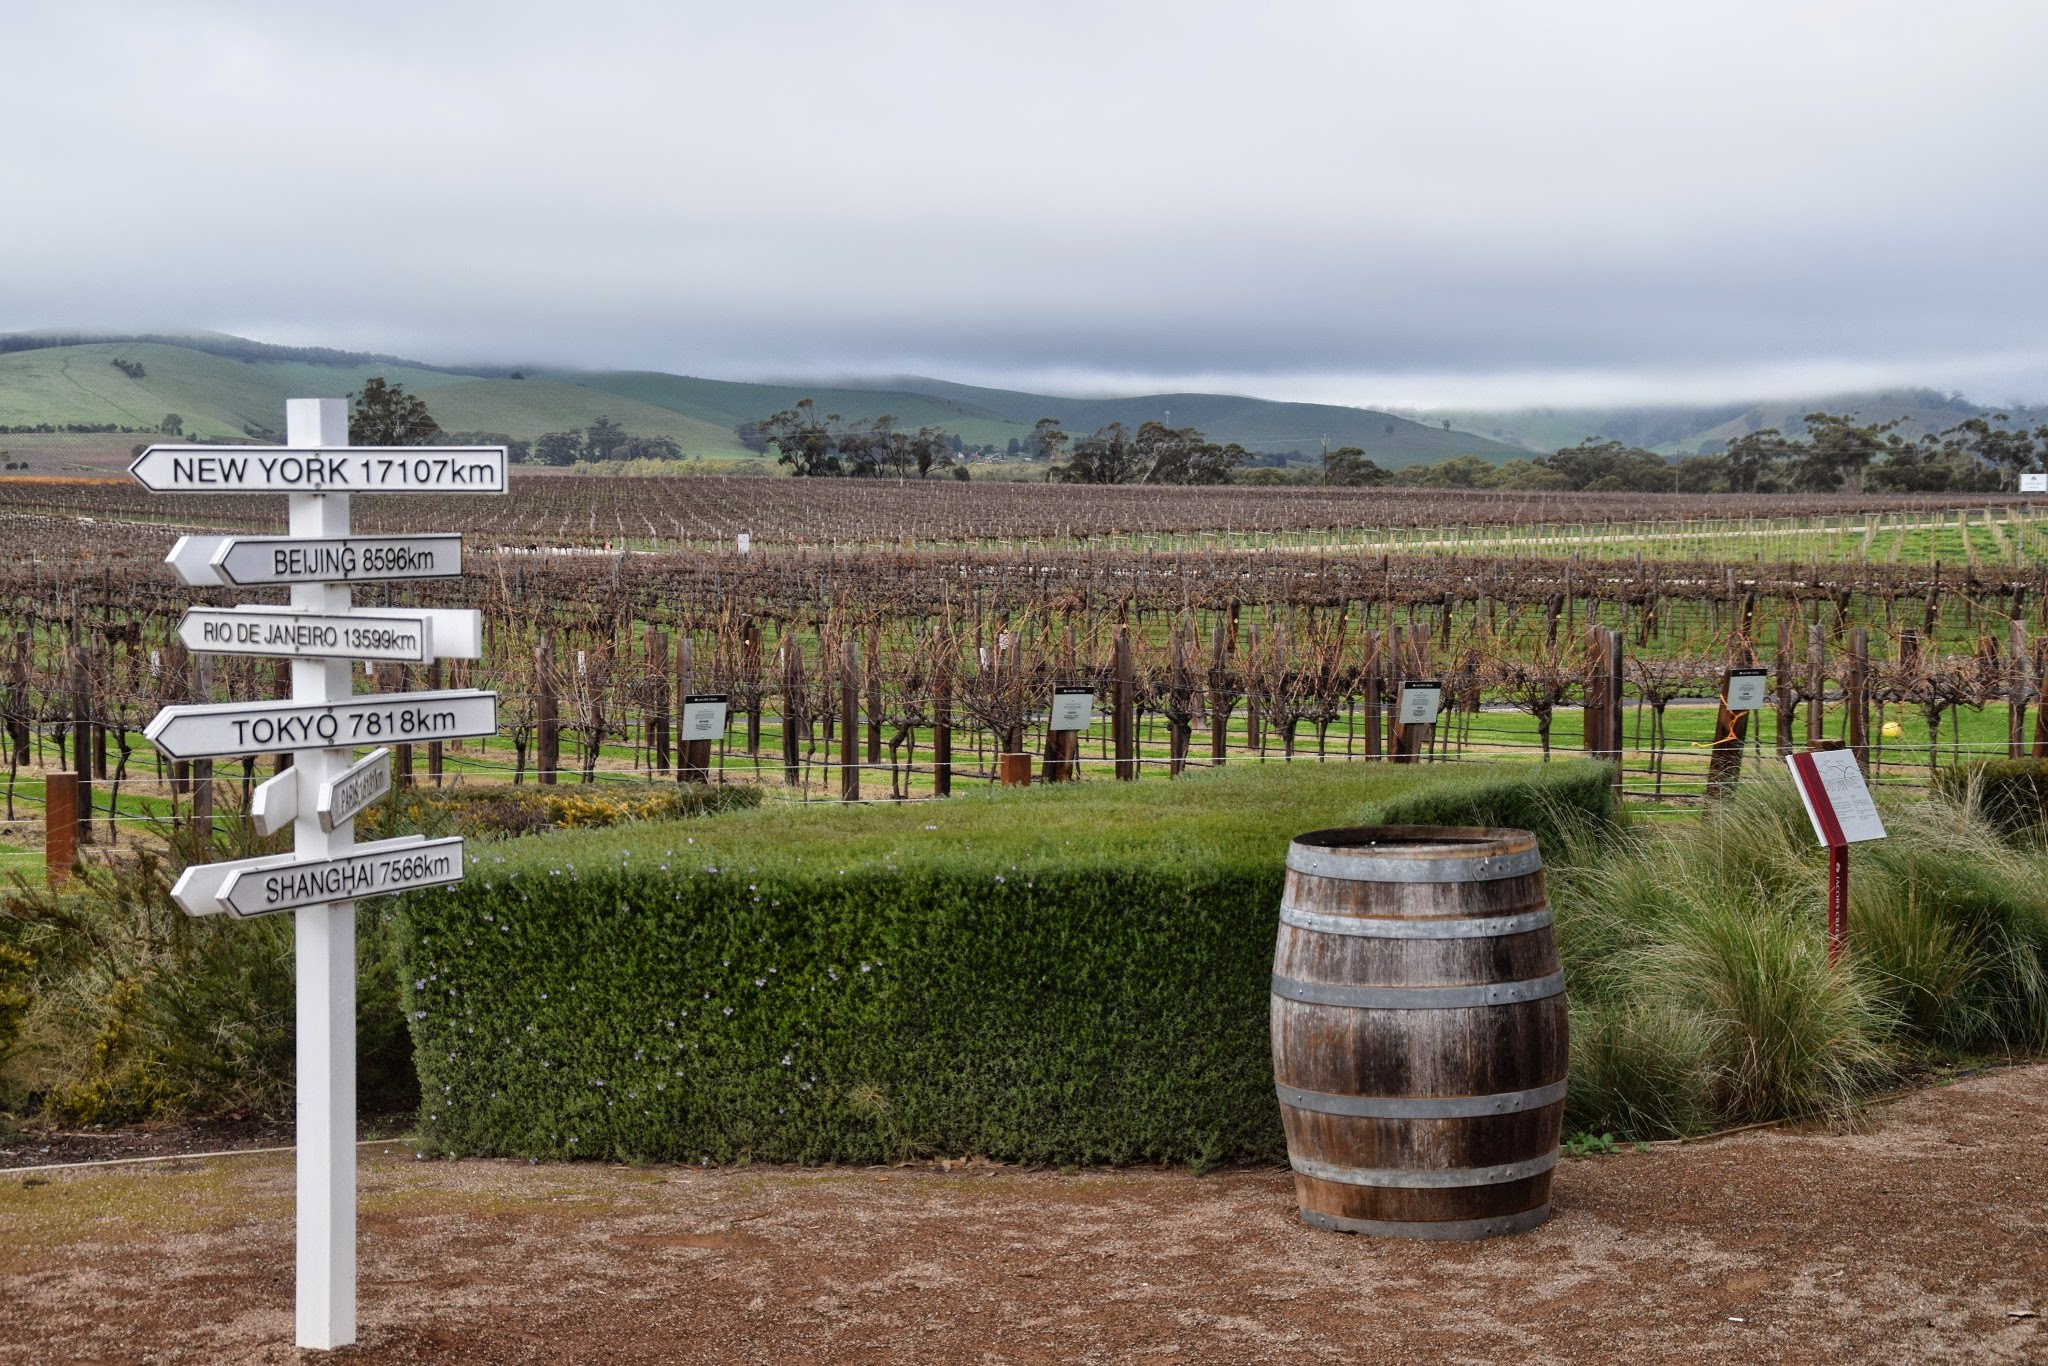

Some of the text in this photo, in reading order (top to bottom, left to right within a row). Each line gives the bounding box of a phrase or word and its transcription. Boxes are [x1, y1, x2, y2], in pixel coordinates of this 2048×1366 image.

[173, 457, 494, 484] NEW YORK 17107km
[274, 547, 434, 575] BEIJING 8596km
[204, 622, 416, 649] RIO DE JANEIRO 13599km
[232, 709, 455, 744] TOKYO 7818km
[341, 780, 358, 814] PARIS
[266, 854, 449, 903] SHANGHAI 7566km
